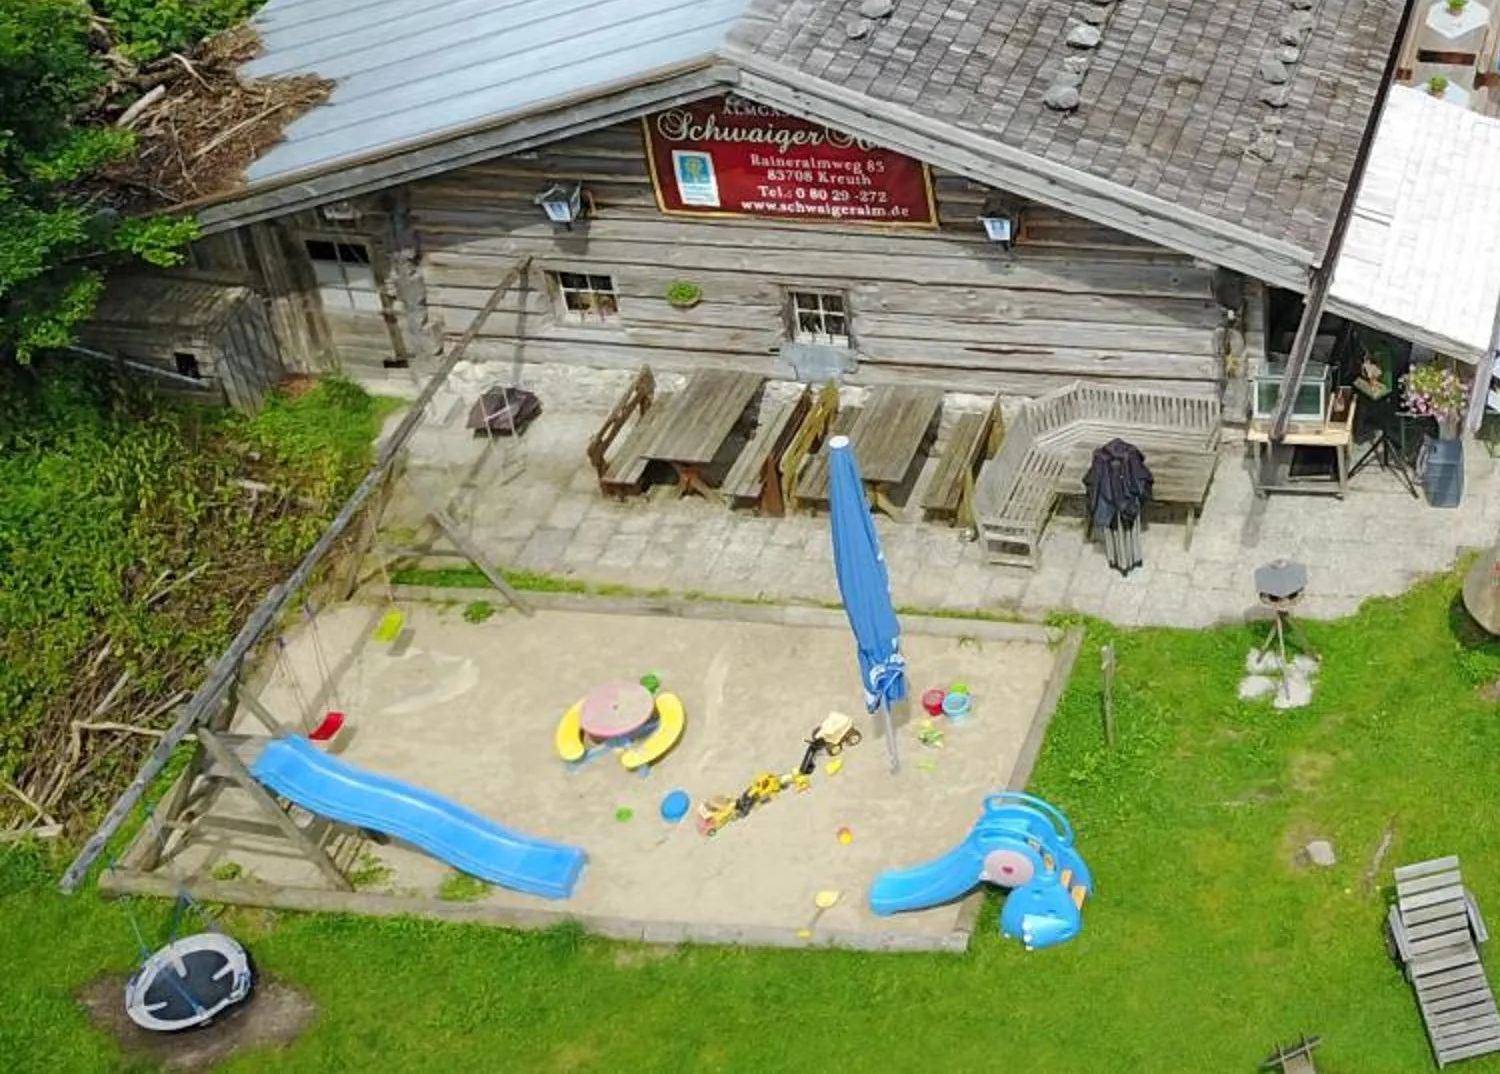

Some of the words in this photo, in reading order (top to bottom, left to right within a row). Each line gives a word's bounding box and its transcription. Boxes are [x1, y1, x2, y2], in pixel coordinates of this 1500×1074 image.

[657, 108, 824, 153] Schwaiger
[751, 154, 863, 174] Raineralmweg
[818, 171, 872, 185] Kreuth
[795, 188, 805, 199] 0
[740, 201, 910, 218] www.schwaigeralm.de
